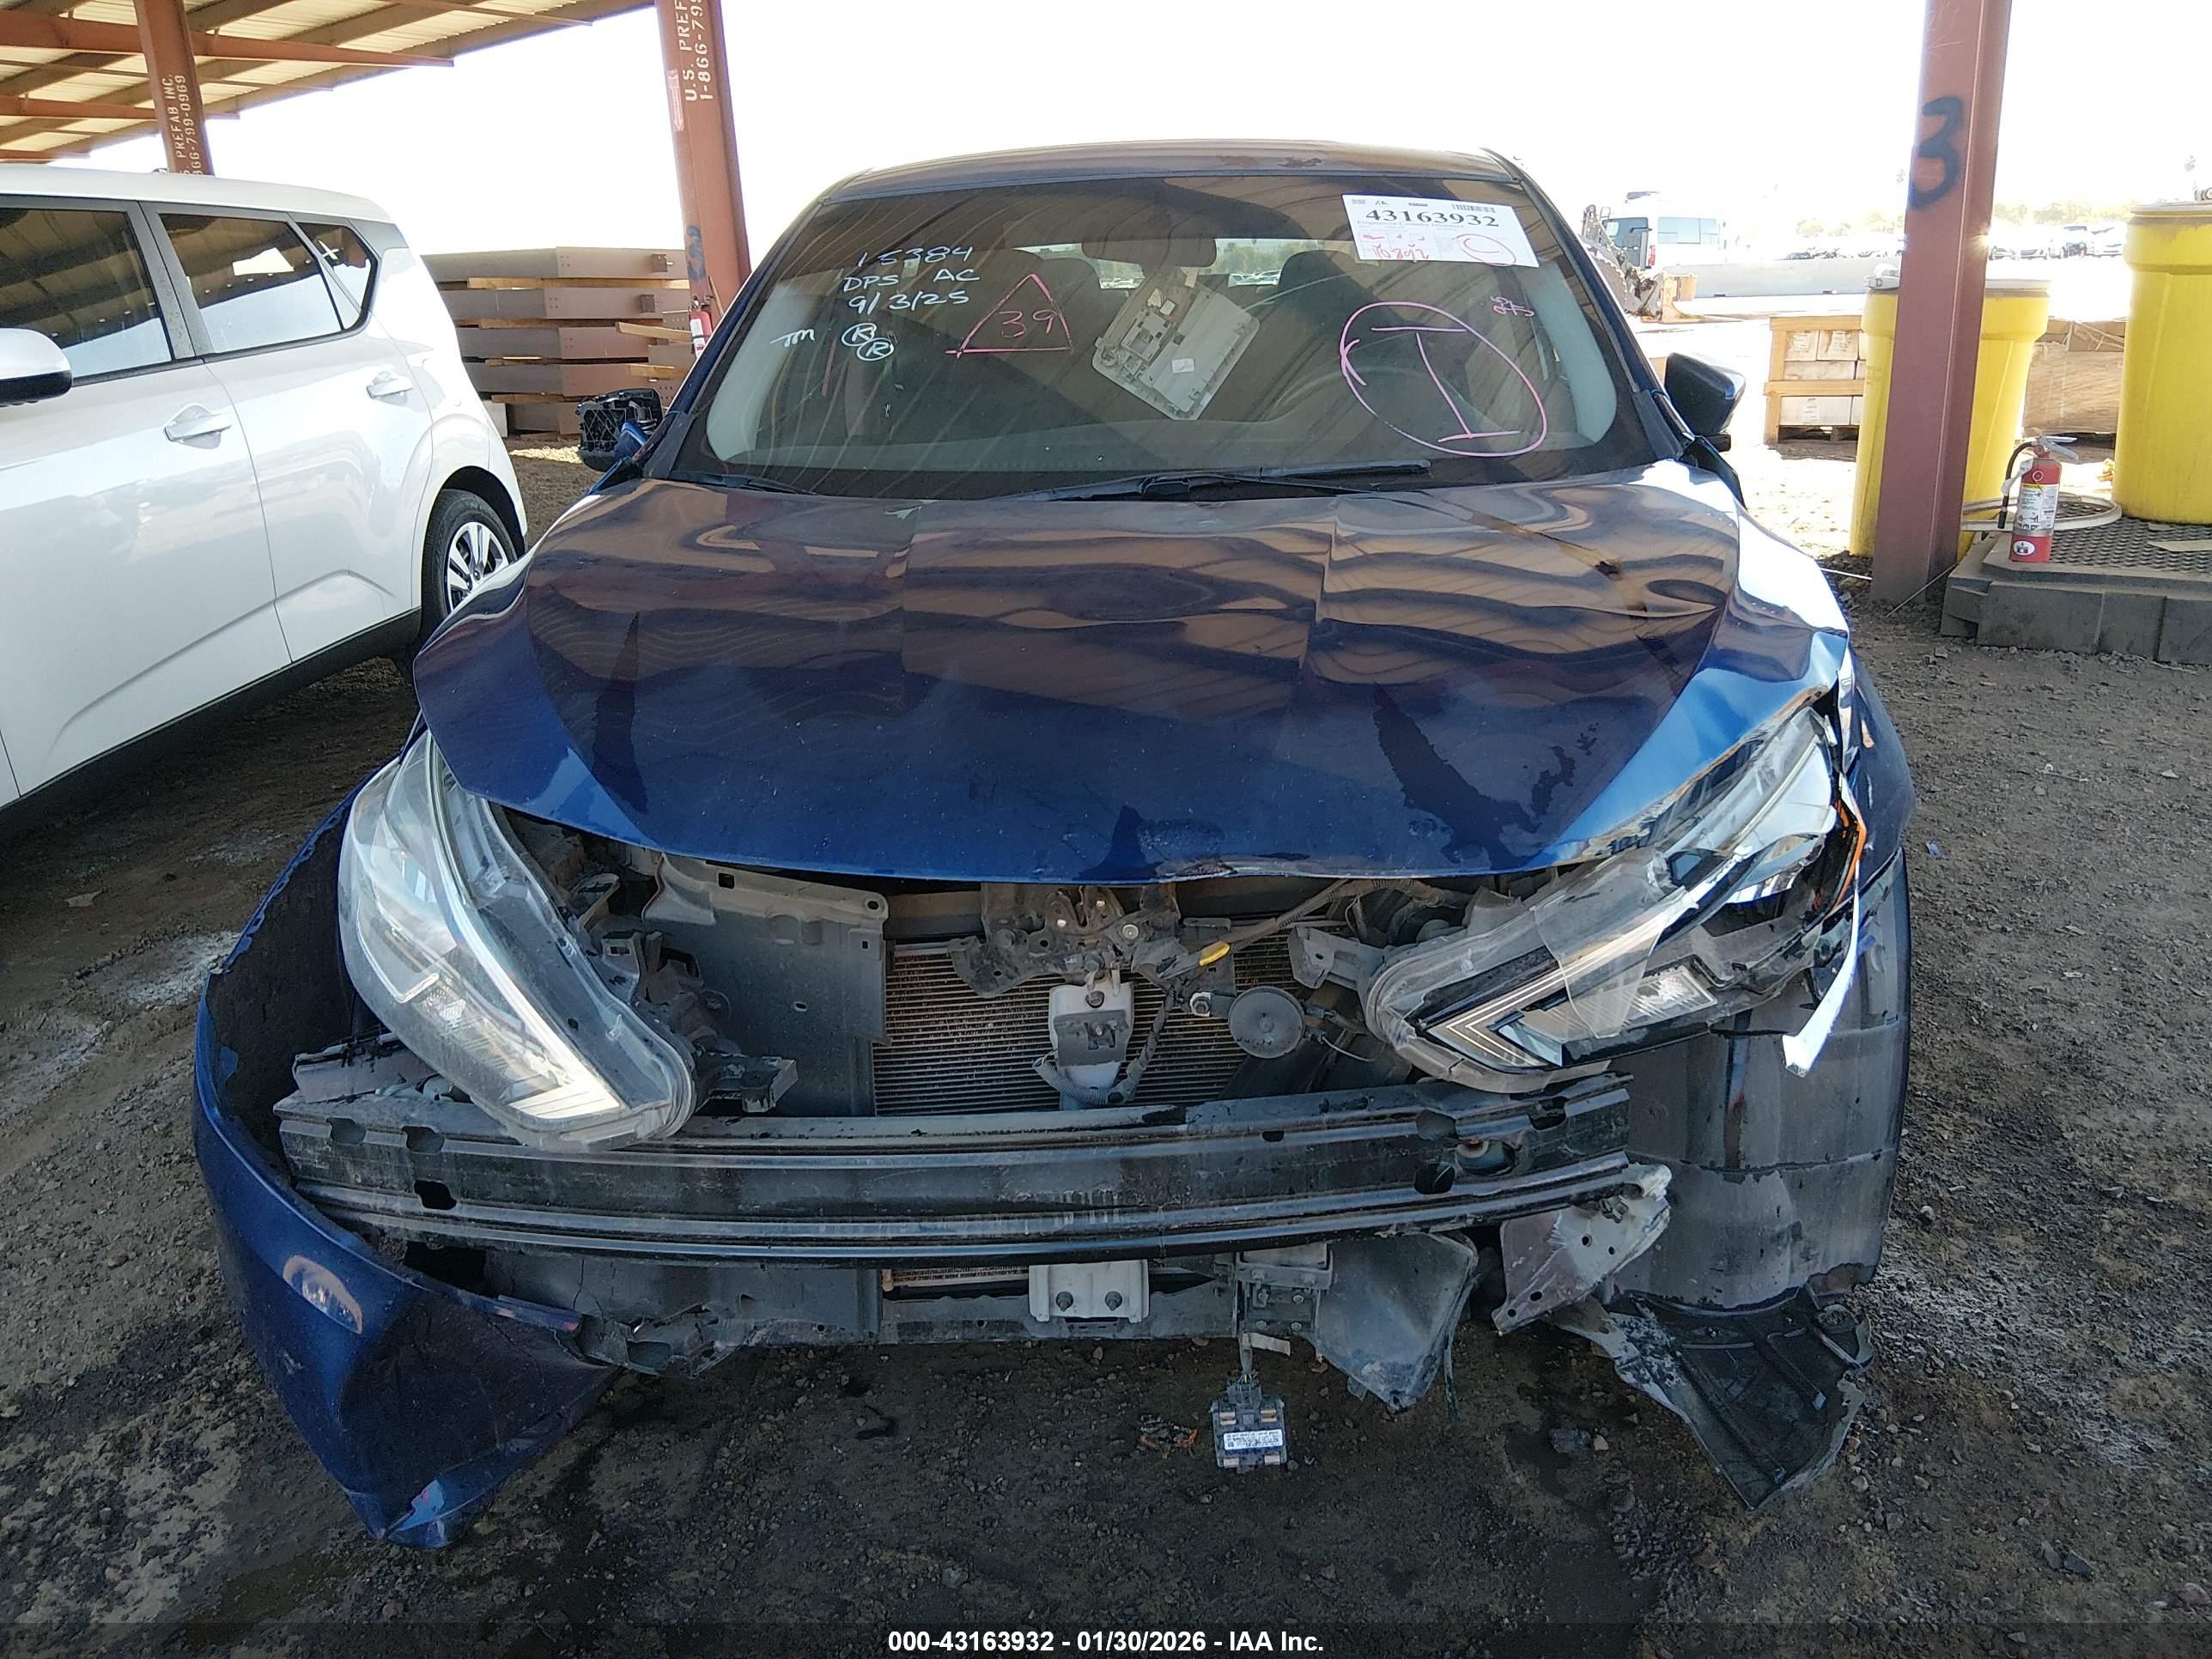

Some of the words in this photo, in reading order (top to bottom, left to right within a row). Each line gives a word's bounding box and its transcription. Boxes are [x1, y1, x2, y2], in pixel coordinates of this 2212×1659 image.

[161, 74, 176, 100] INC.
[683, 64, 697, 101] U.S.
[167, 106, 186, 158] PREFAB
[1909, 96, 1964, 211] 3
[1365, 210, 1499, 228] 43163932
[843, 276, 899, 293] DPS
[933, 269, 981, 283] AC
[999, 309, 1059, 337] 39
